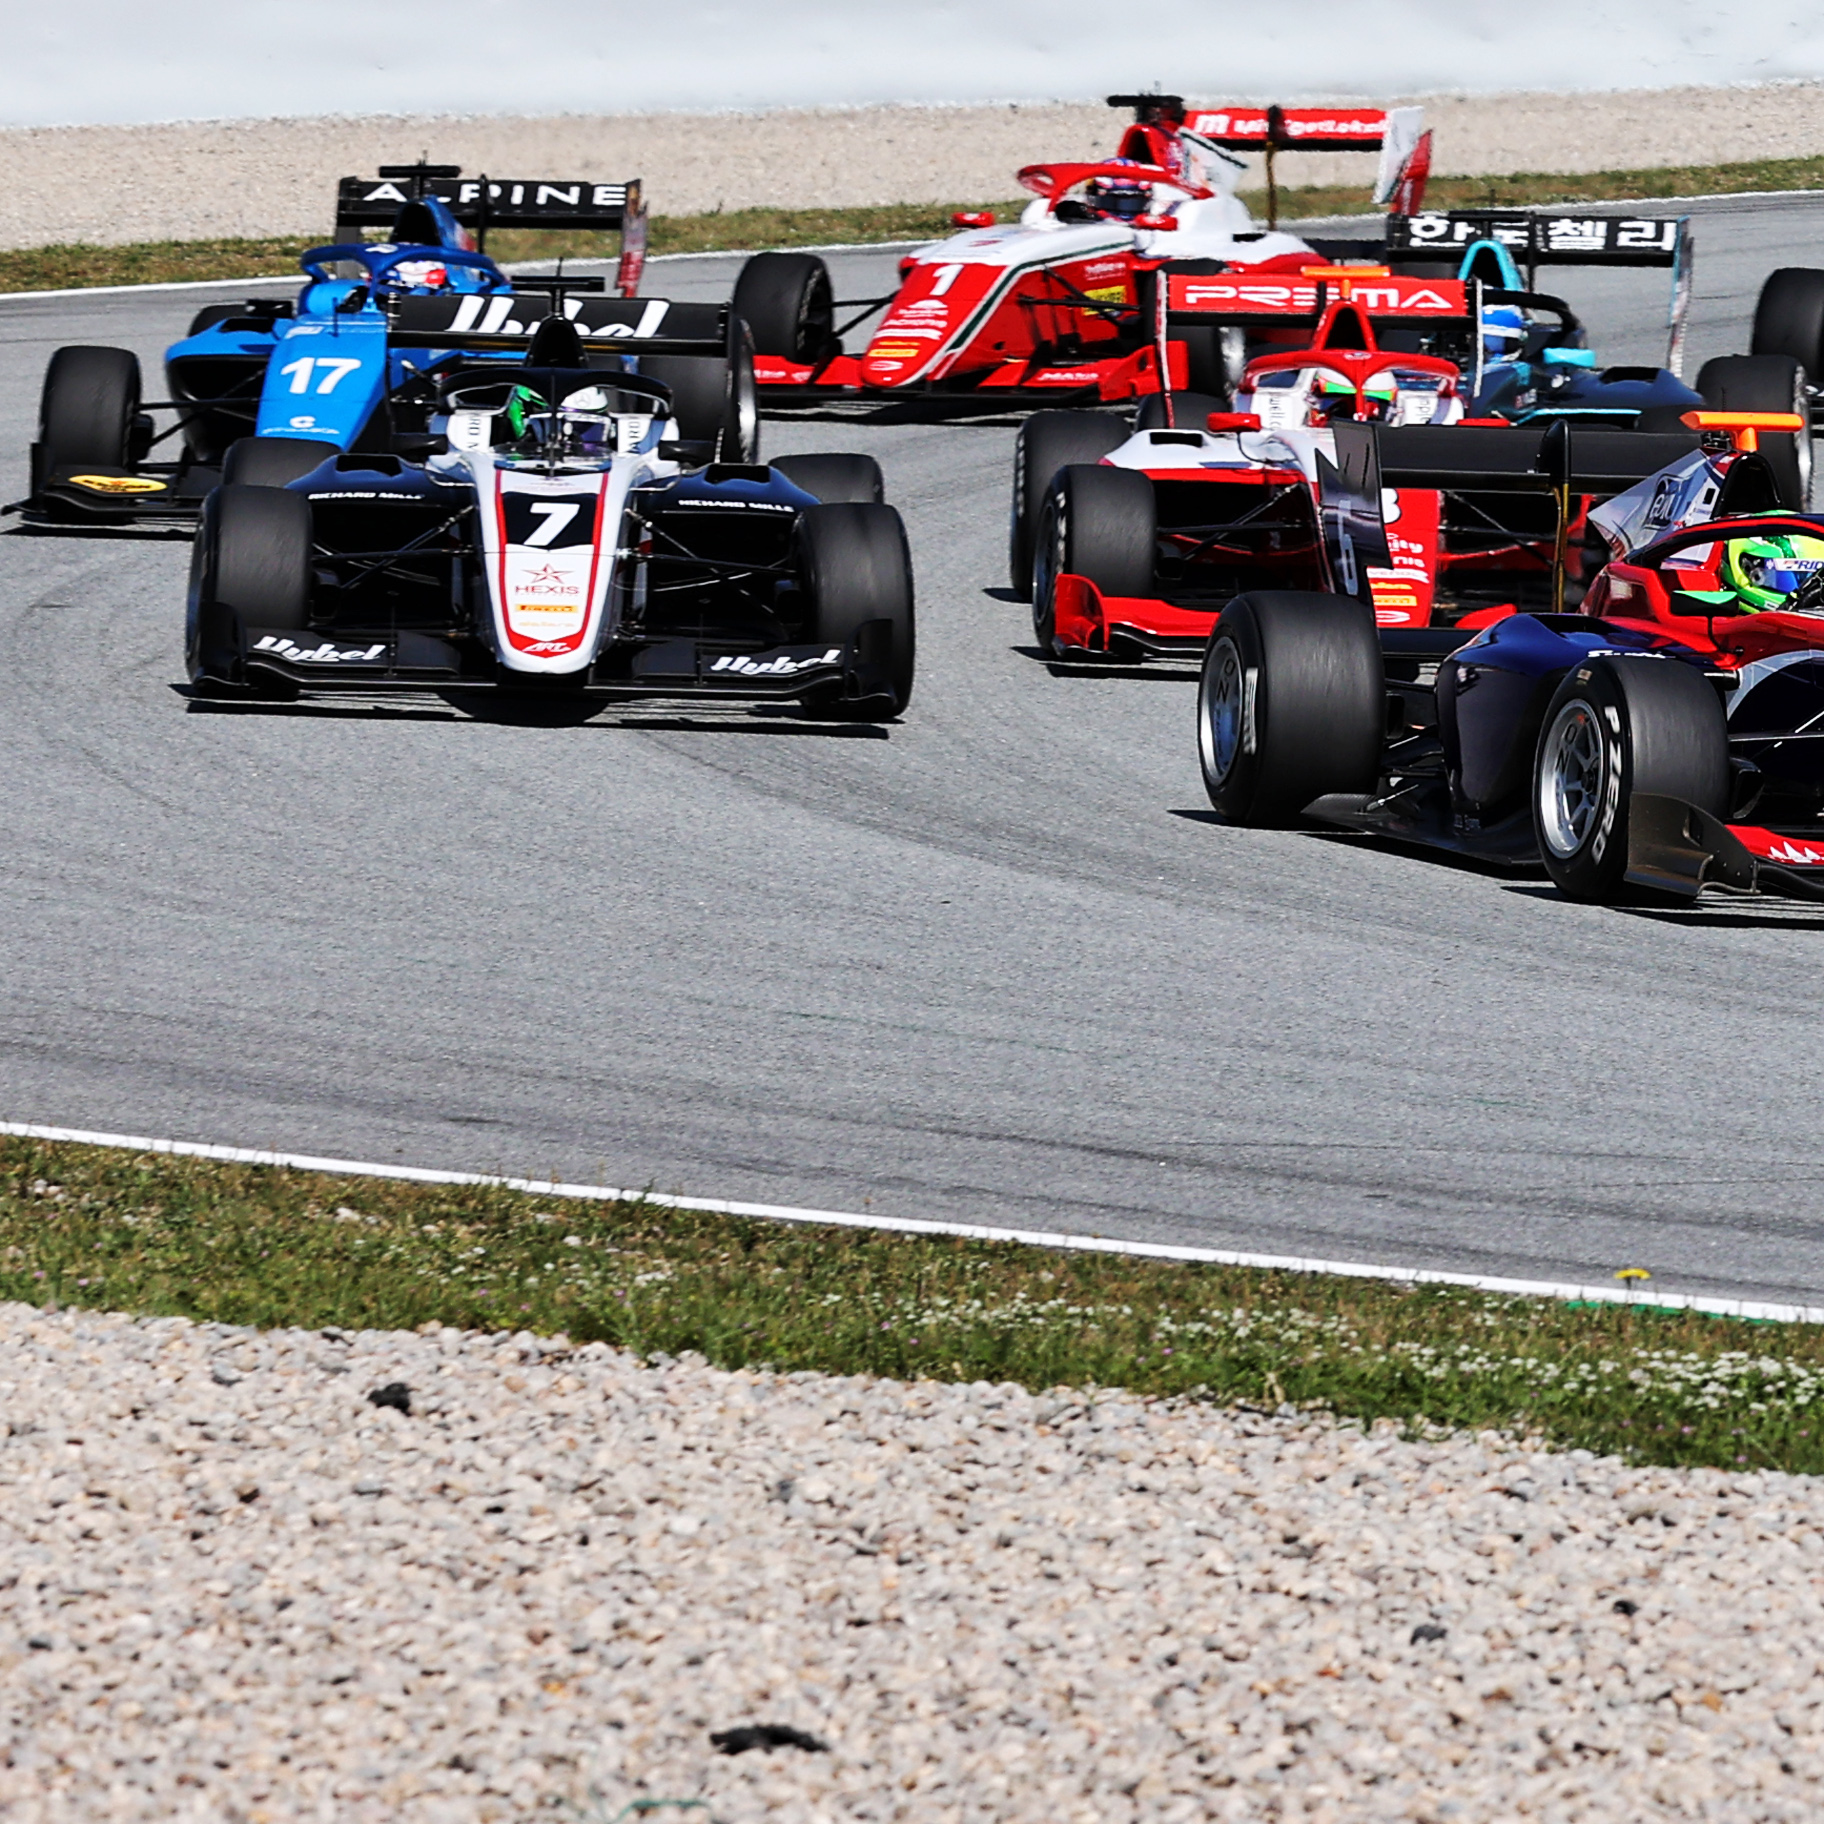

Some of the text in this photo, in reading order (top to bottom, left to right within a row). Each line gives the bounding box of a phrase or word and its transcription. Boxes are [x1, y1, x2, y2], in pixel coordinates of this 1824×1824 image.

[362, 182, 627, 207] APINE
[930, 264, 963, 296] 1
[1185, 284, 1453, 309] PREMA
[280, 356, 362, 394] 17
[308, 491, 377, 500] RICHARD
[678, 499, 747, 509] RICHARD
[523, 501, 581, 547] 7
[514, 584, 580, 595] HEXIS
[253, 635, 387, 662] Hybel
[710, 649, 842, 676] Hybel
